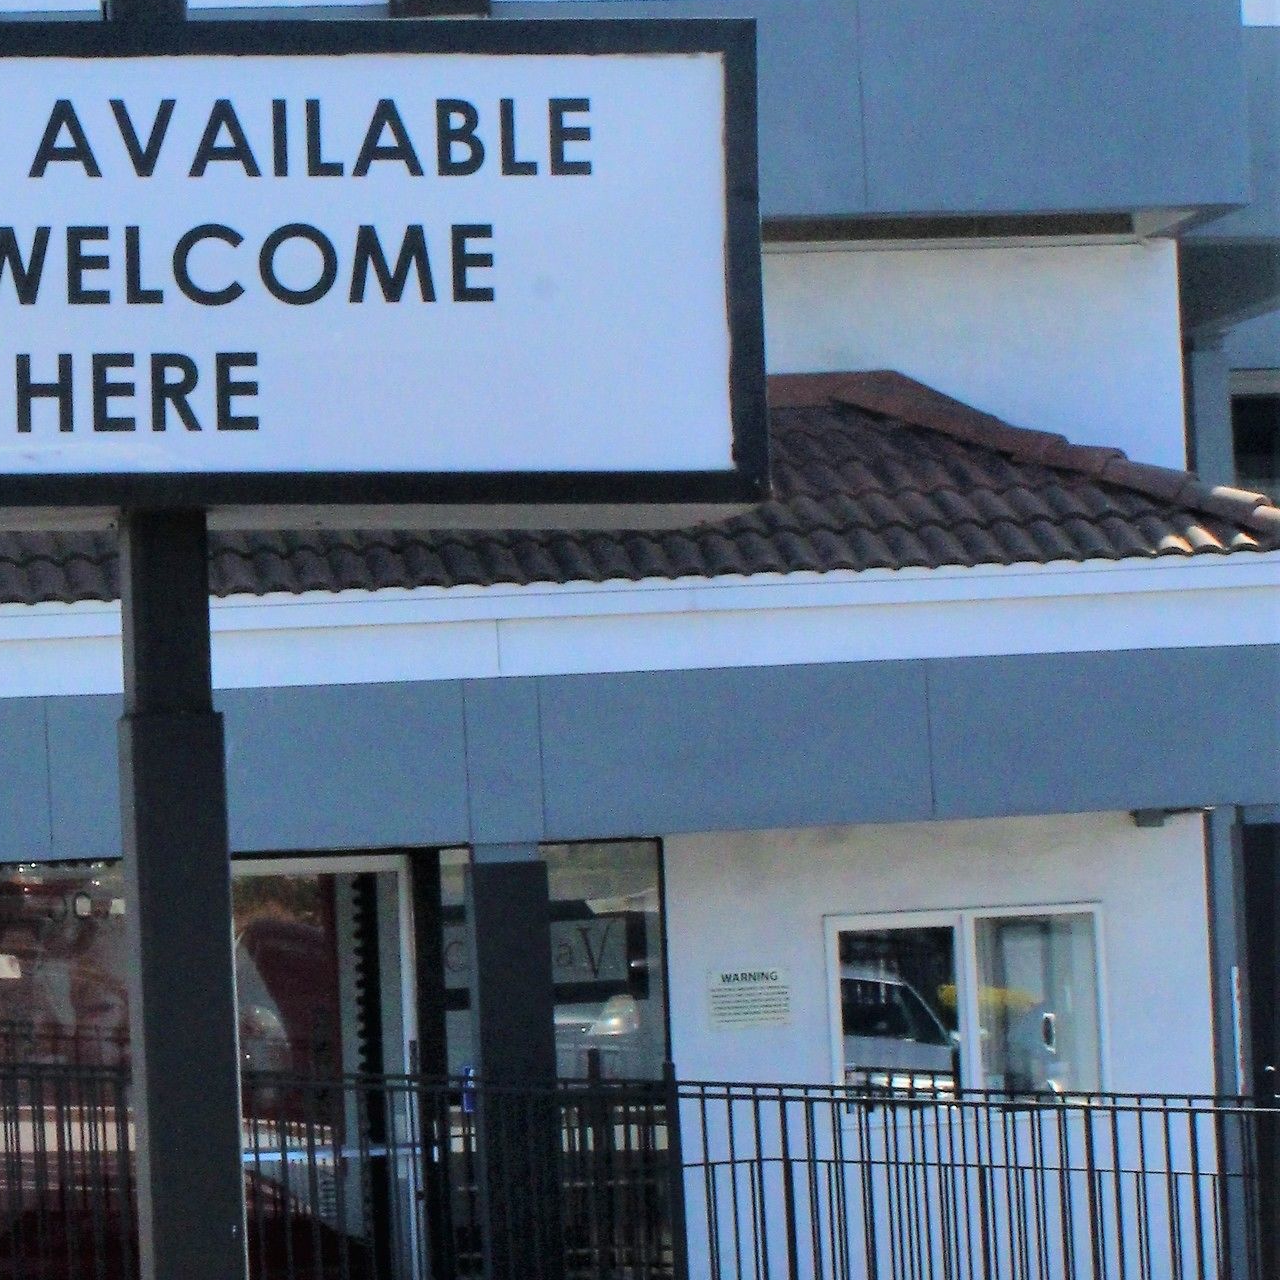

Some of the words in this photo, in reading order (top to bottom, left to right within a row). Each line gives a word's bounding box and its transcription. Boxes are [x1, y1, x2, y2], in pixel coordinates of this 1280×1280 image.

[29, 99, 591, 177] AVAILABLE
[16, 352, 259, 432] HERE
[721, 971, 778, 983] WARNING
